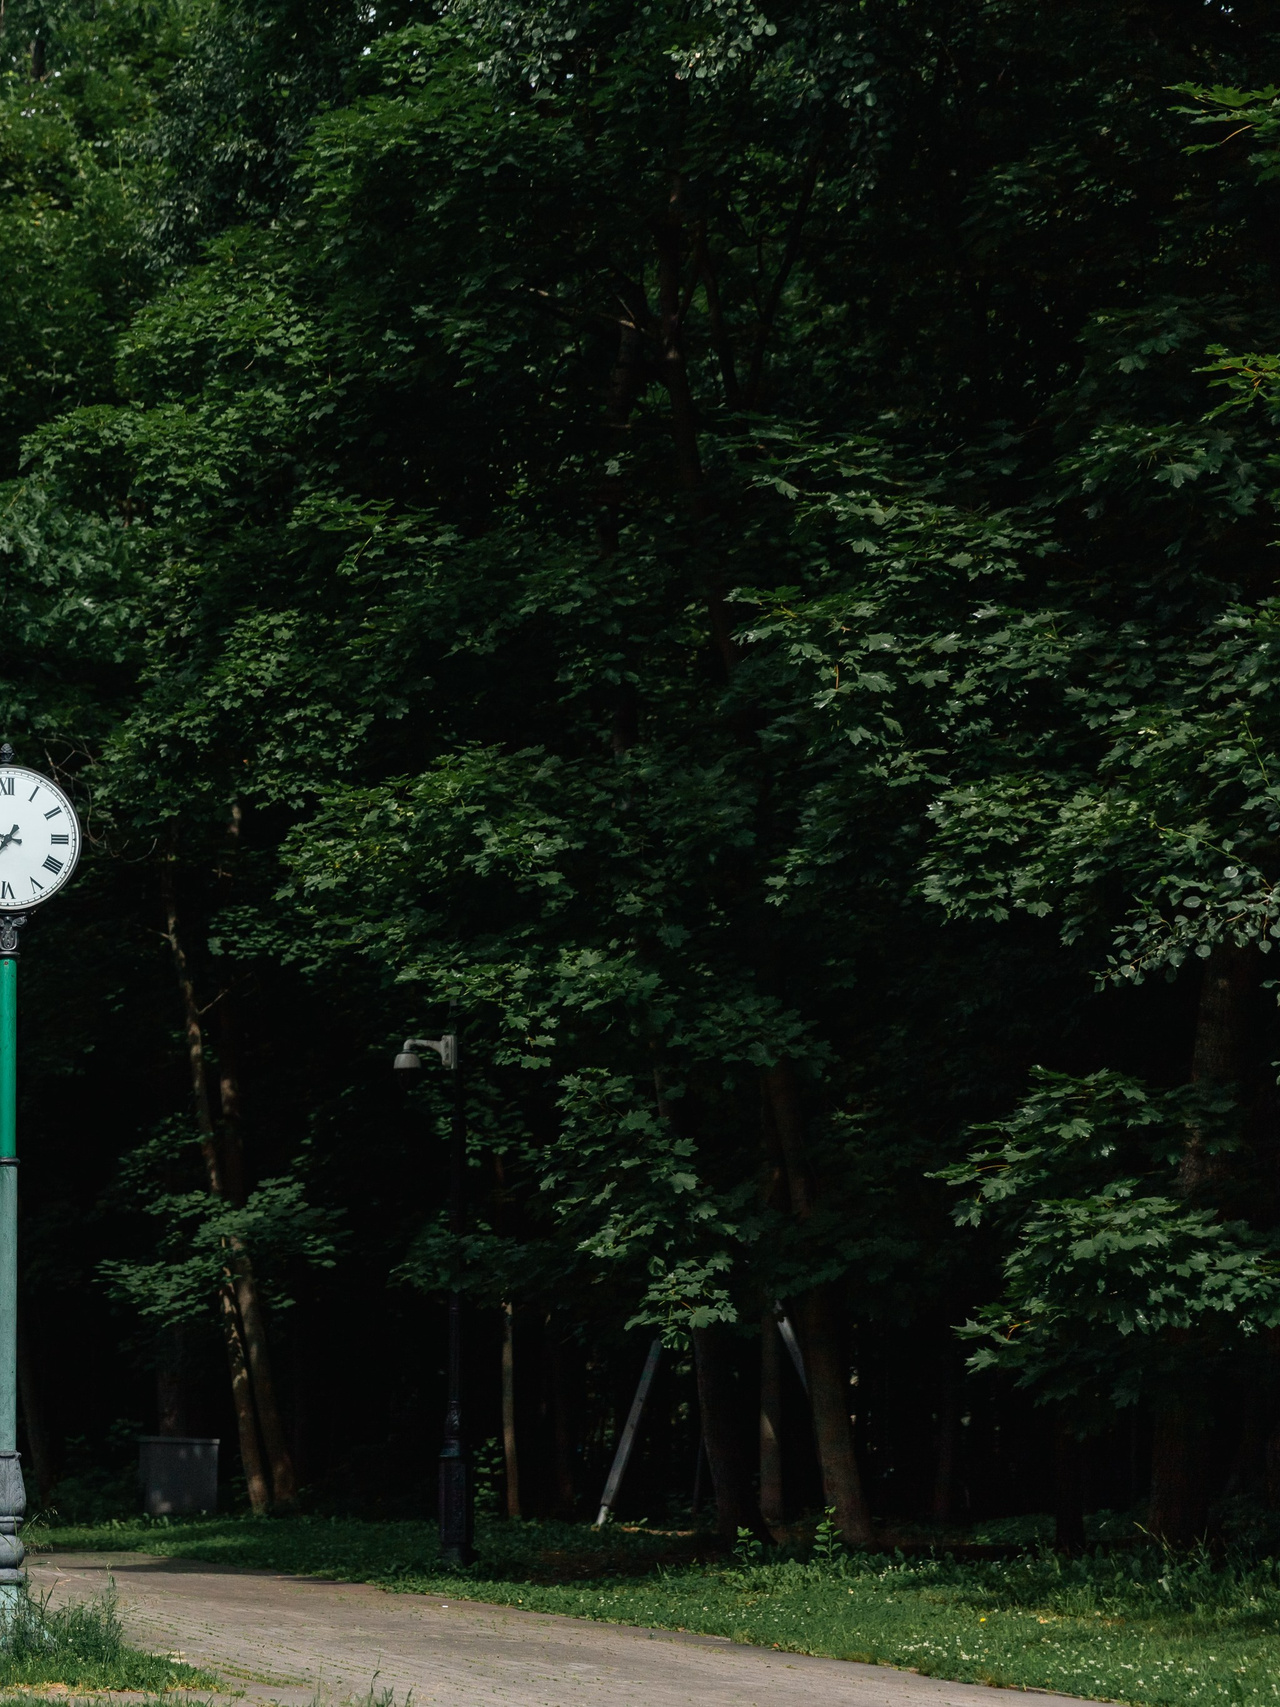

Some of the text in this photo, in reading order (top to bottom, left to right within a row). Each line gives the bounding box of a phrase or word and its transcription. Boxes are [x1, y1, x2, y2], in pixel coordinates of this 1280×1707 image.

[28, 786, 40, 803] I
[44, 806, 63, 820] II
[51, 834, 69, 845] III
[42, 855, 64, 875] IIII
[1, 881, 16, 899] VI
[30, 876, 45, 894] V
